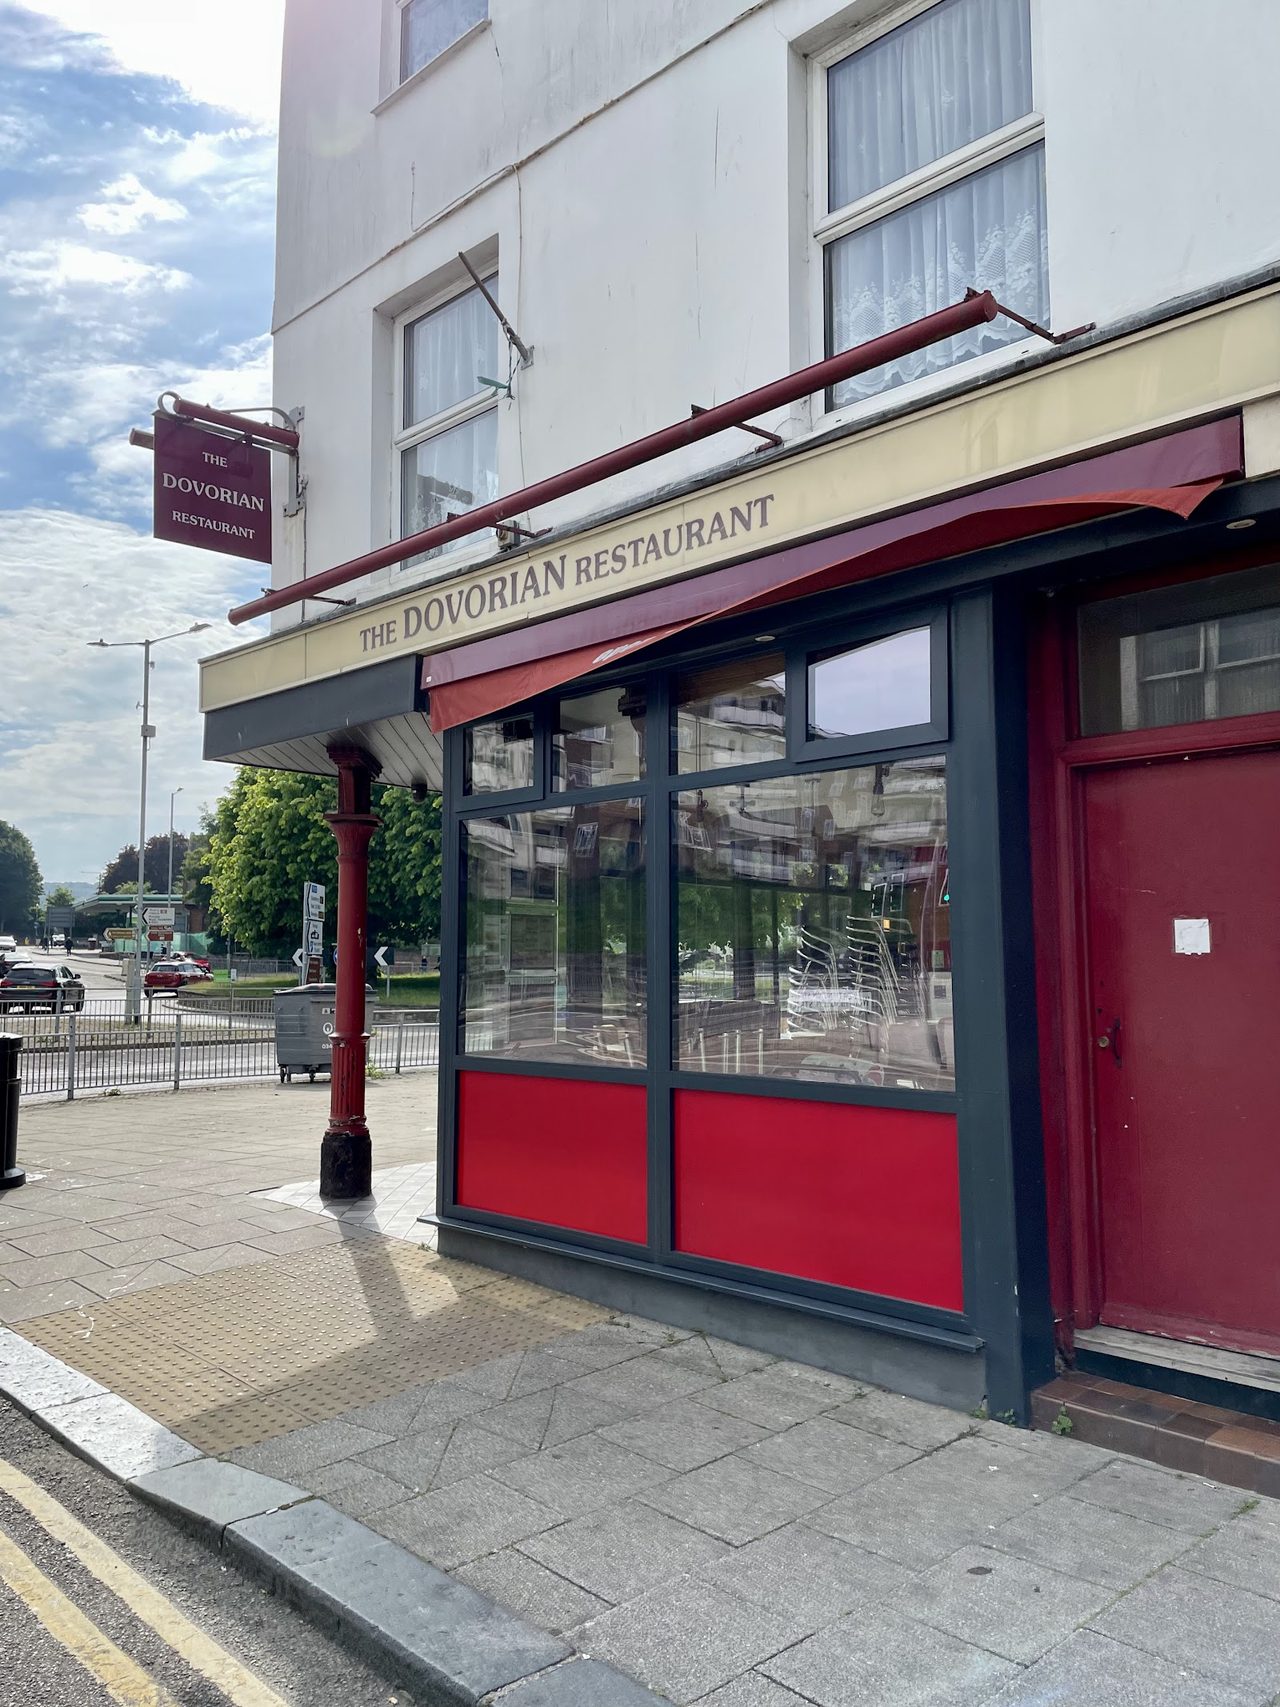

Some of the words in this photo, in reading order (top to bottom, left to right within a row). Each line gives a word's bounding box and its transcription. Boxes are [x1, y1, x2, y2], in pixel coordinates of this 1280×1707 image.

[203, 452, 227, 467] THE
[163, 473, 264, 511] DOVORIAN
[172, 511, 255, 539] RESTAURANT
[360, 619, 397, 652] THE
[403, 555, 566, 639] DOVORIAN
[575, 494, 774, 586] RESTAURANT
